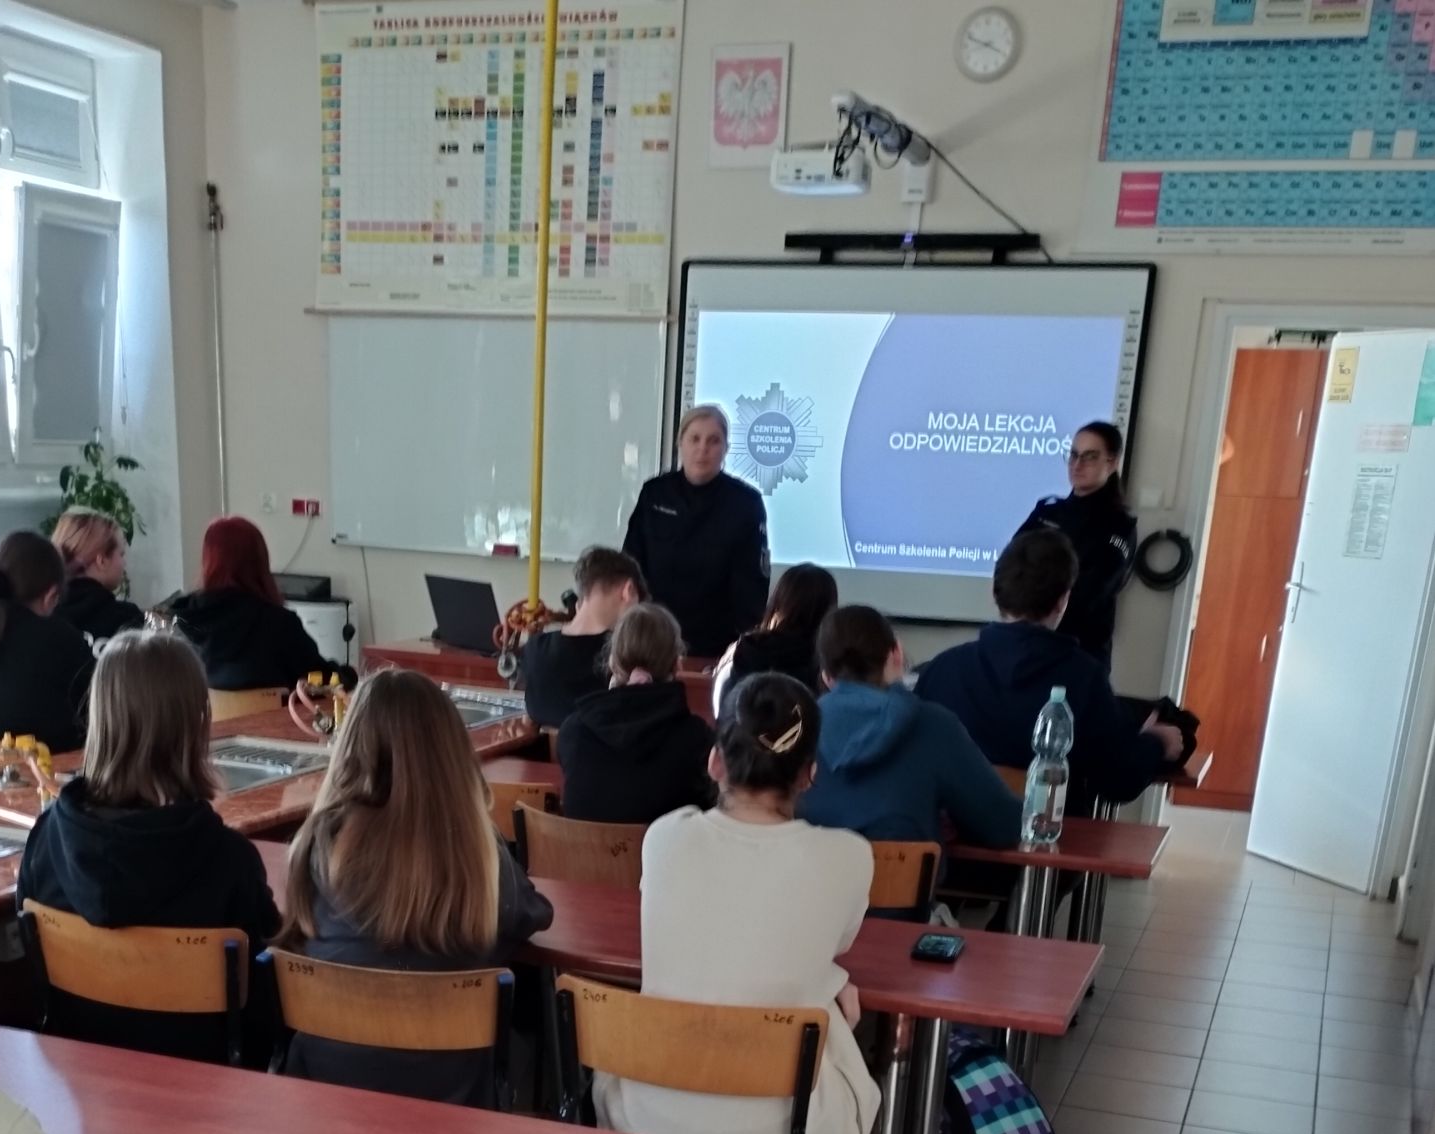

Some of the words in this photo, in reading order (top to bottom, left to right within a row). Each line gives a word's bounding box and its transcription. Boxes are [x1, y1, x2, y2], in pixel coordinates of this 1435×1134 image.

[927, 411, 980, 432] MOJA
[984, 414, 1056, 433] LEKCJA
[753, 425, 790, 434] CENTRUM
[750, 435, 792, 444] SZKOLENIA
[756, 445, 785, 454] POLICJI
[855, 541, 896, 555] Centrum
[899, 543, 946, 558] Szkolenia
[949, 546, 980, 562] Policji
[983, 551, 991, 561] w
